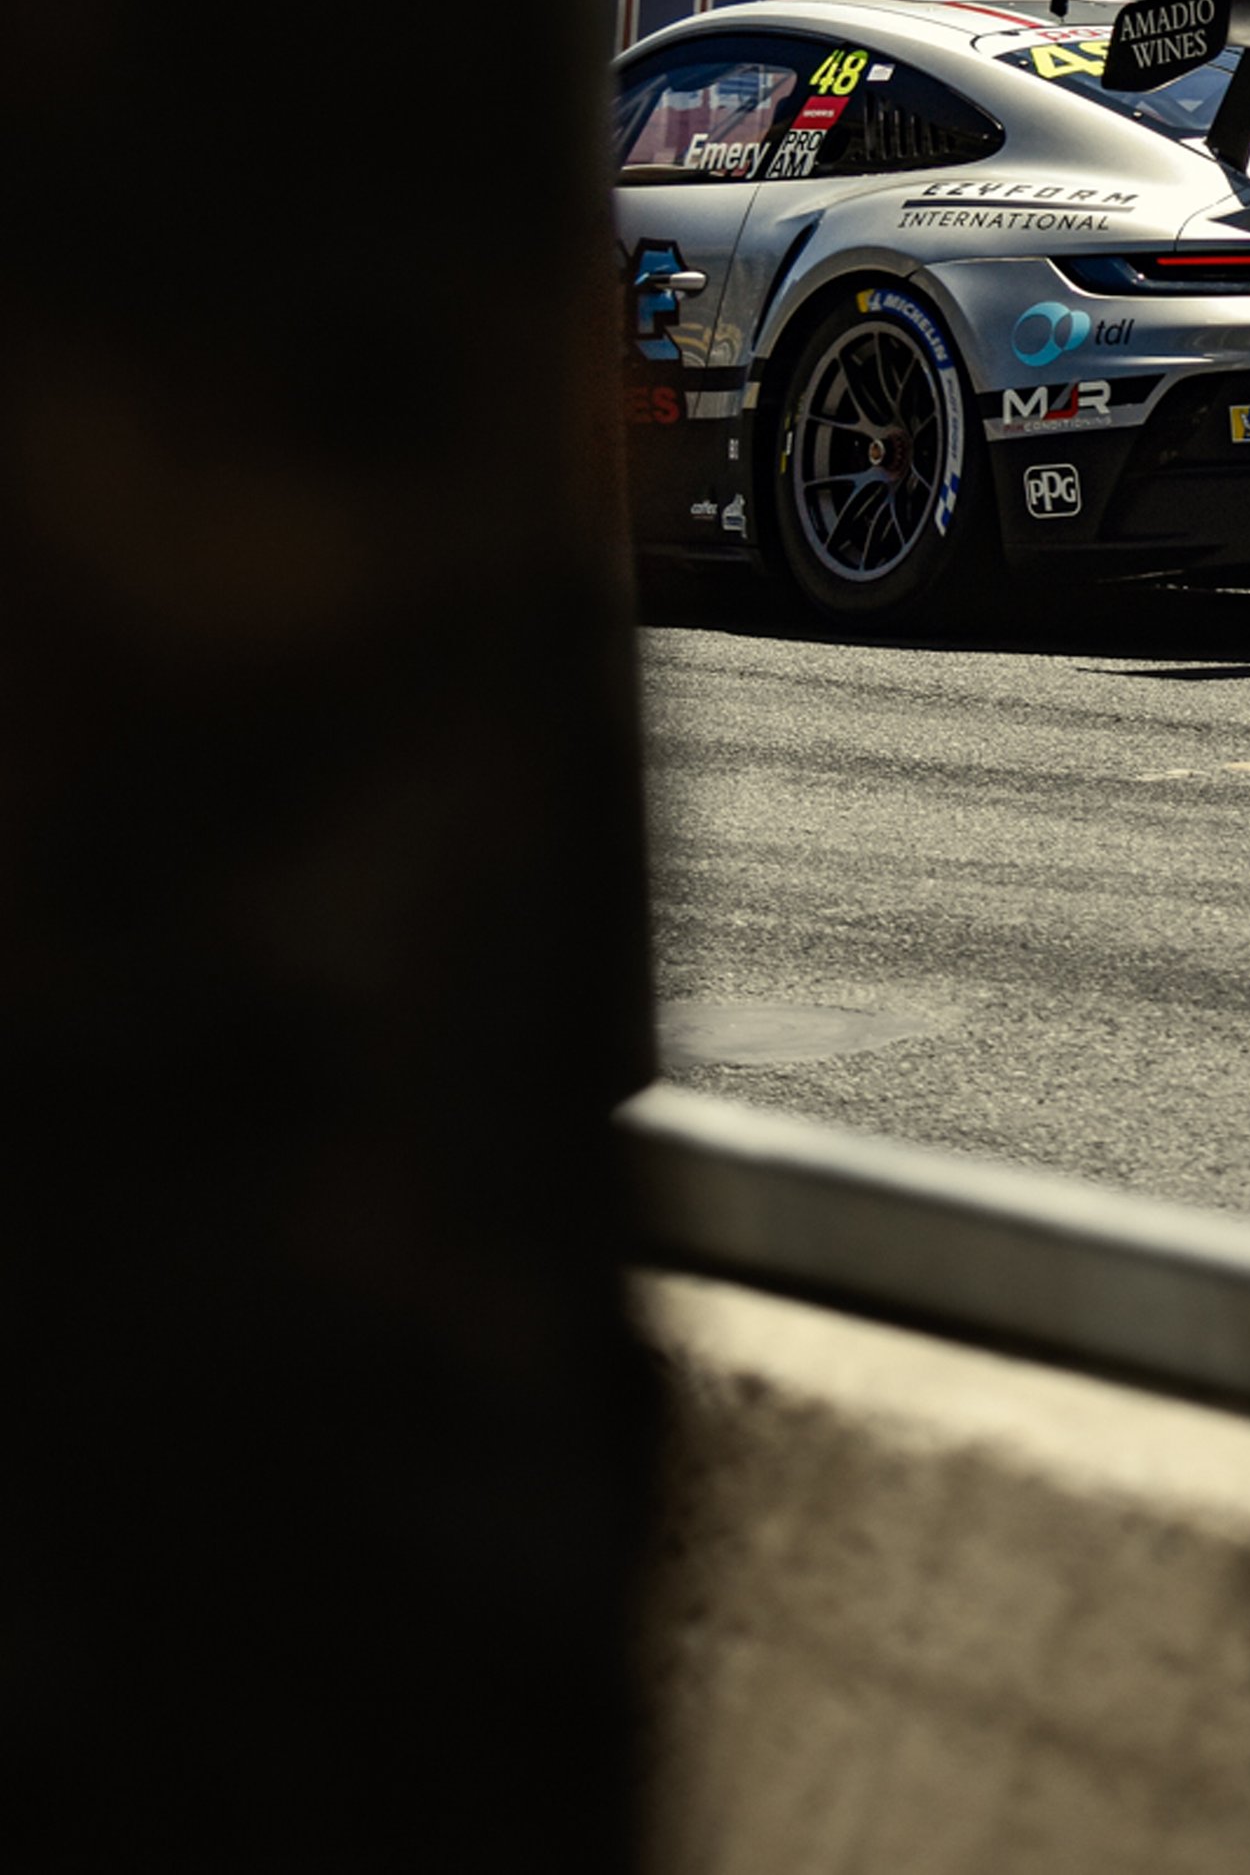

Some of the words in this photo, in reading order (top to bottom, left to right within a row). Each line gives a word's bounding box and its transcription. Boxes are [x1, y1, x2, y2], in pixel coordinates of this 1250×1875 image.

[1131, 29, 1207, 69] WINES
[809, 49, 869, 96] 48
[683, 133, 772, 179] Emery
[922, 182, 1139, 205] EZYFORM
[898, 210, 1111, 232] INTERNATIONAL
[882, 292, 948, 363] MICHELIN
[1095, 318, 1135, 346] tdl
[1027, 471, 1077, 512] PPG
